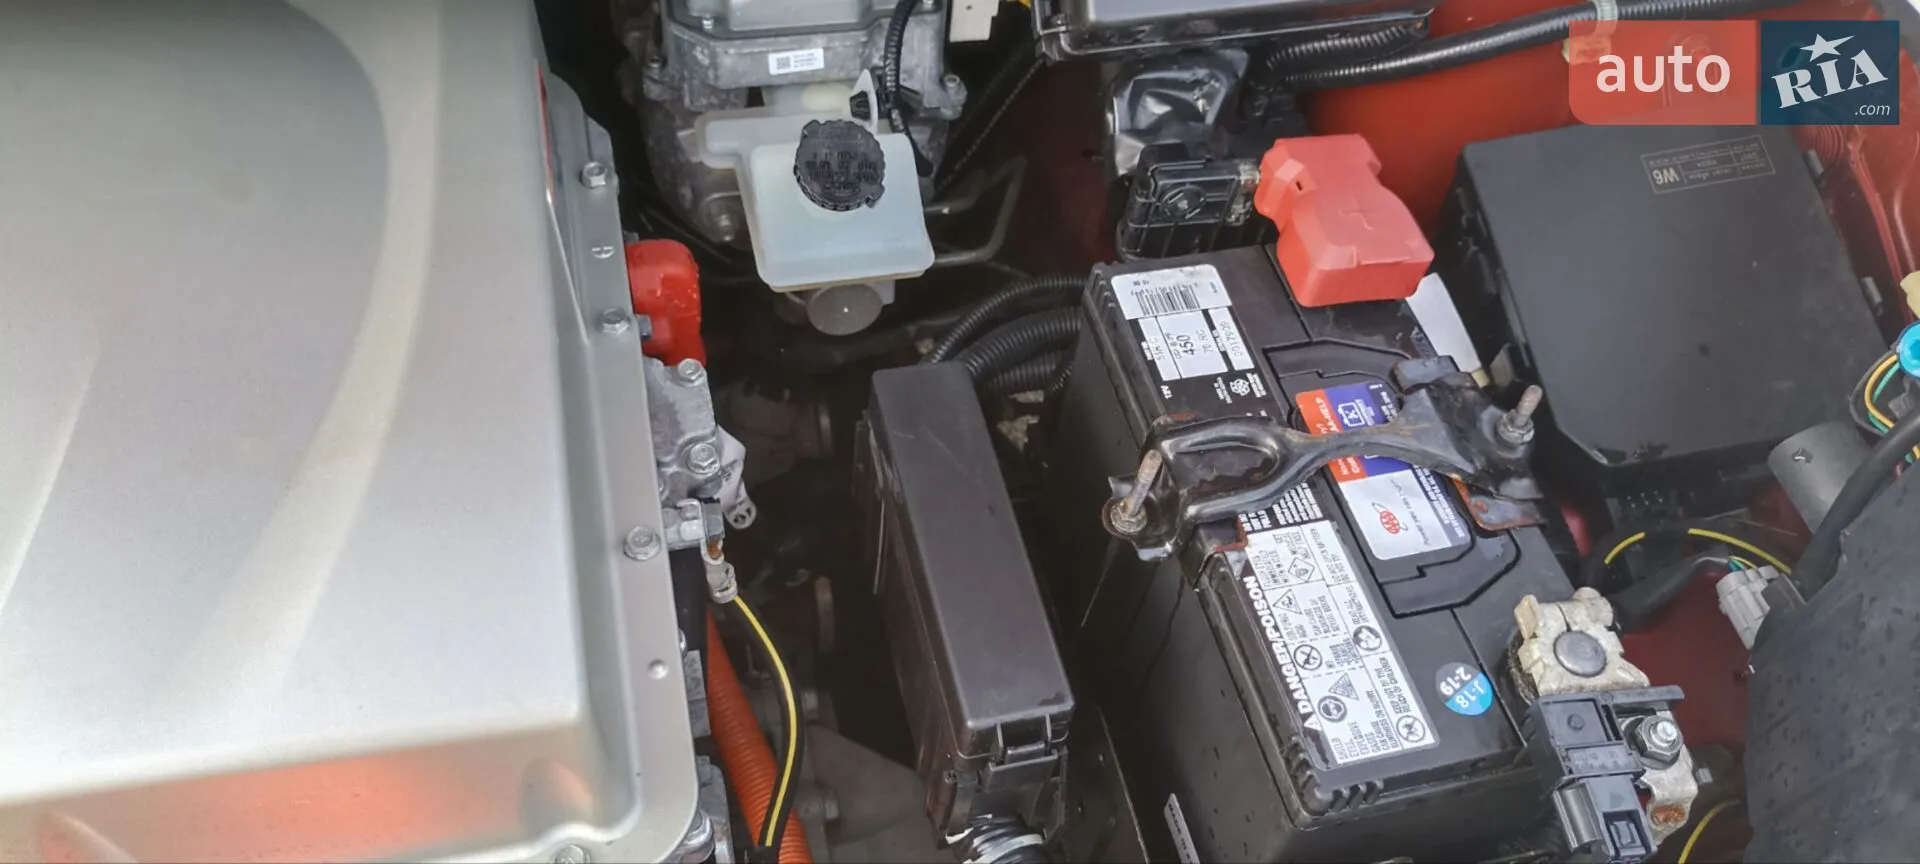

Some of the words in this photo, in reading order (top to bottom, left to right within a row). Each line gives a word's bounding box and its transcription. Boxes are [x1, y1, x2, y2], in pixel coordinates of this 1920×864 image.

[1176, 334, 1195, 355] 450
[1381, 511, 1400, 533] AAA
[1243, 576, 1312, 714] DANGER/POISON
[1439, 666, 1472, 696] 2-19
